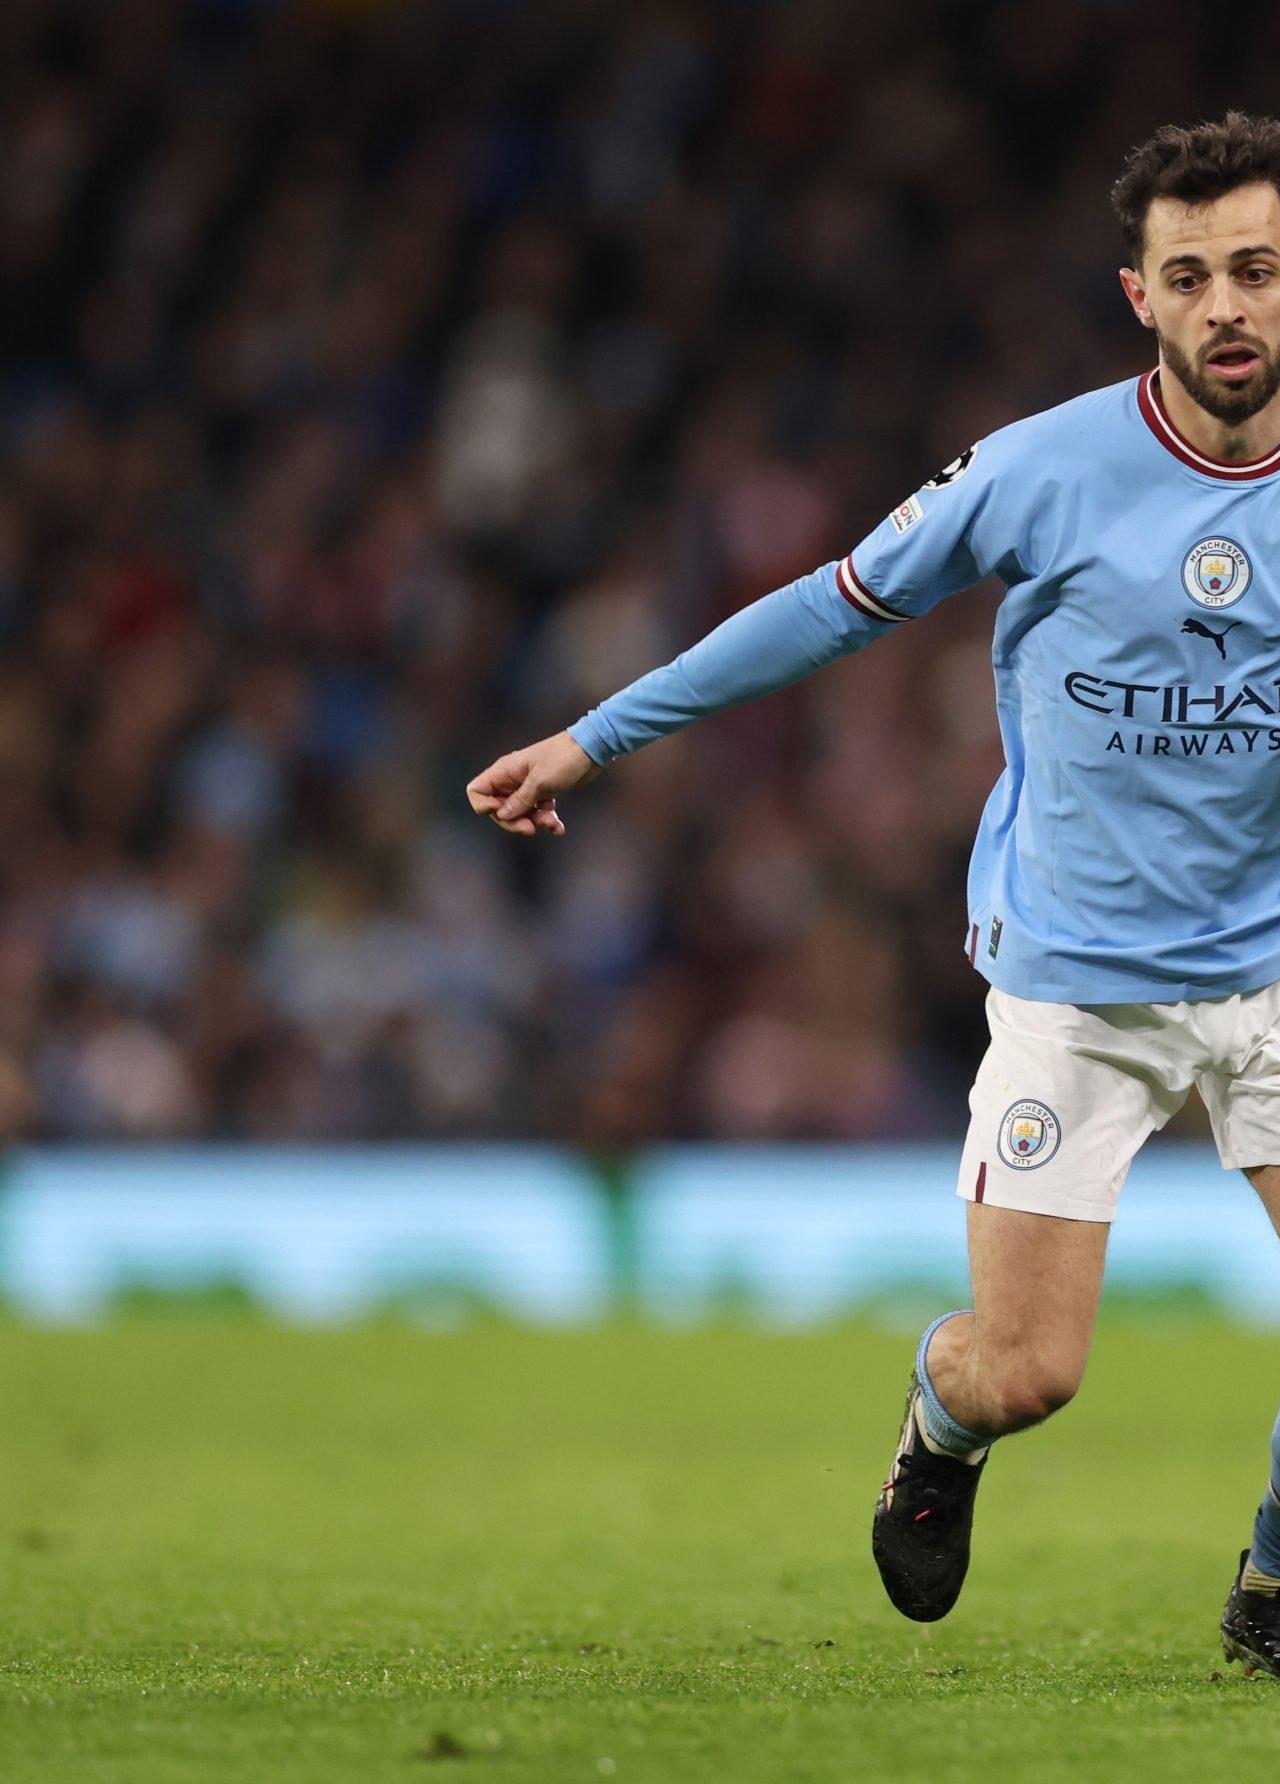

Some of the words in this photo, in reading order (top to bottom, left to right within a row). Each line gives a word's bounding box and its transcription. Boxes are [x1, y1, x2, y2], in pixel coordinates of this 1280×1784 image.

[1190, 541, 1245, 566] MANCHESTER
[1204, 596, 1225, 605] CITY
[1006, 1104, 1055, 1130] MANCHESTER
[1012, 1157, 1032, 1166] CITY
